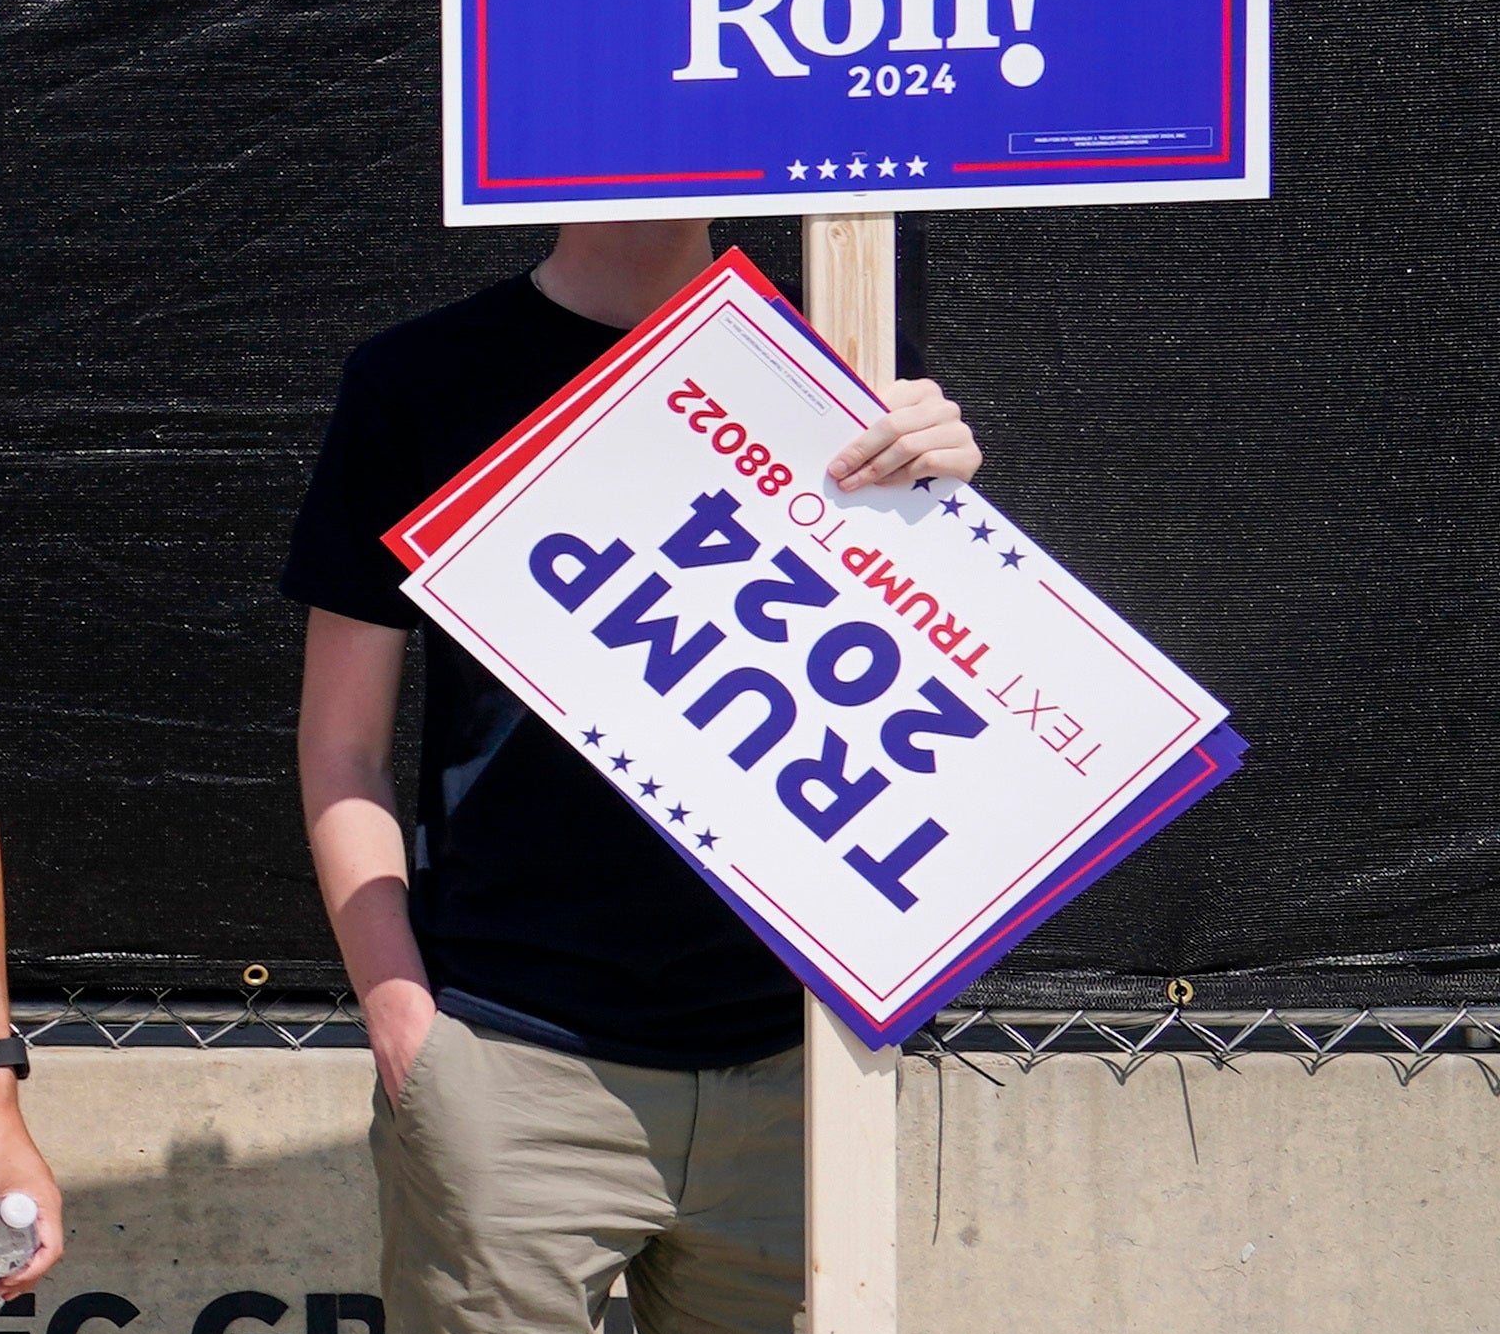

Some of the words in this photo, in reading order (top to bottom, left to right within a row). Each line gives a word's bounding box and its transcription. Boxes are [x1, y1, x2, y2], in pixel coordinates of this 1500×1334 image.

[847, 62, 957, 98] 2024
[666, 376, 794, 498] 88022
[787, 492, 843, 550] TO
[658, 487, 990, 775] 2024
[841, 545, 991, 675] TRUMP
[529, 531, 950, 914] TRUMP
[986, 670, 1107, 776] TEXT
